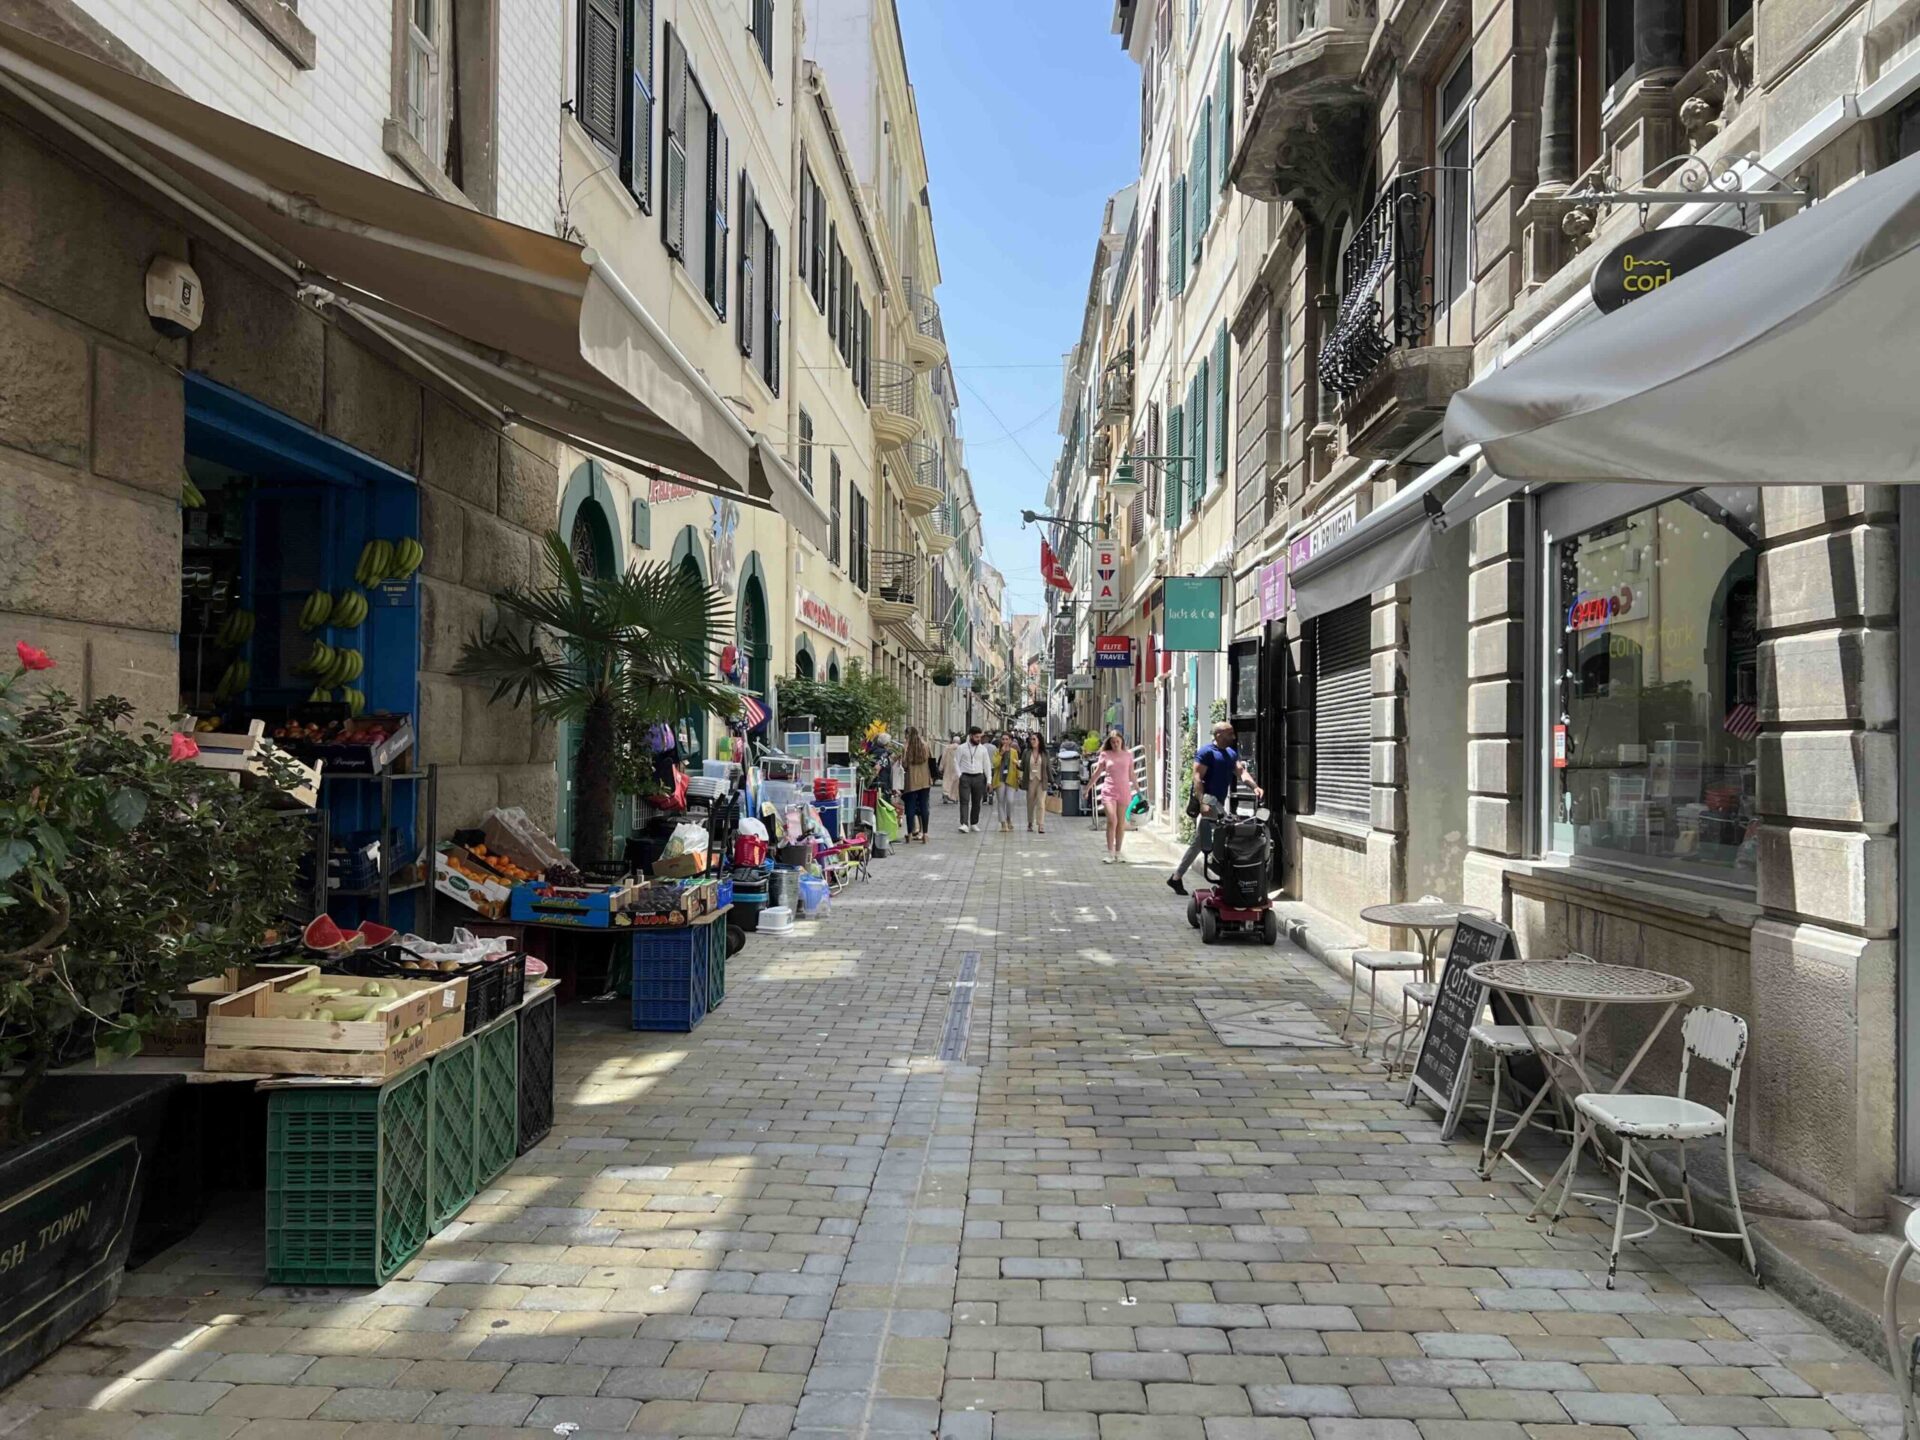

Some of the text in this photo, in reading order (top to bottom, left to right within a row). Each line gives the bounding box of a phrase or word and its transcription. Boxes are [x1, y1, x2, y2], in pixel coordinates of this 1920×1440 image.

[1571, 599, 1607, 631] OPEN
[1609, 630, 1641, 658] cork
[1660, 617, 1695, 650] fork
[1444, 964, 1481, 1004] COFFEE
[38, 1200, 93, 1251] TOWN
